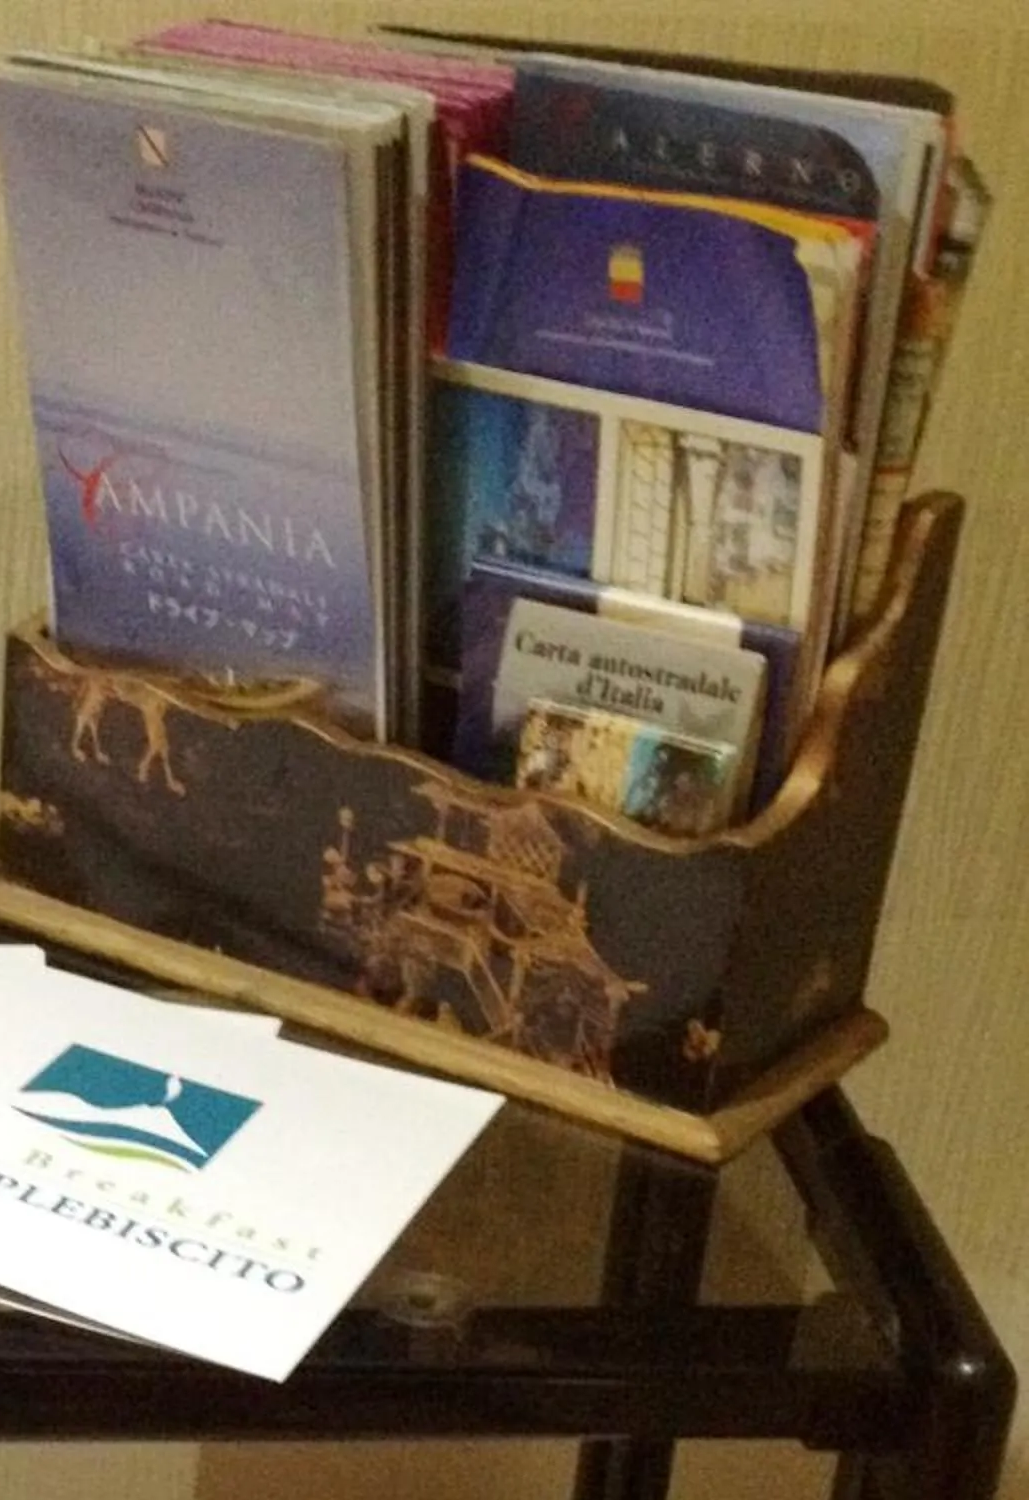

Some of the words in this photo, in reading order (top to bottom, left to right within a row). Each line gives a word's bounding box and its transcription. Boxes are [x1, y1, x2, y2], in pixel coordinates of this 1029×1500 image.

[514, 630, 582, 668] Carta
[588, 650, 741, 706] autostradale
[23, 1149, 324, 1263] Breakfast
